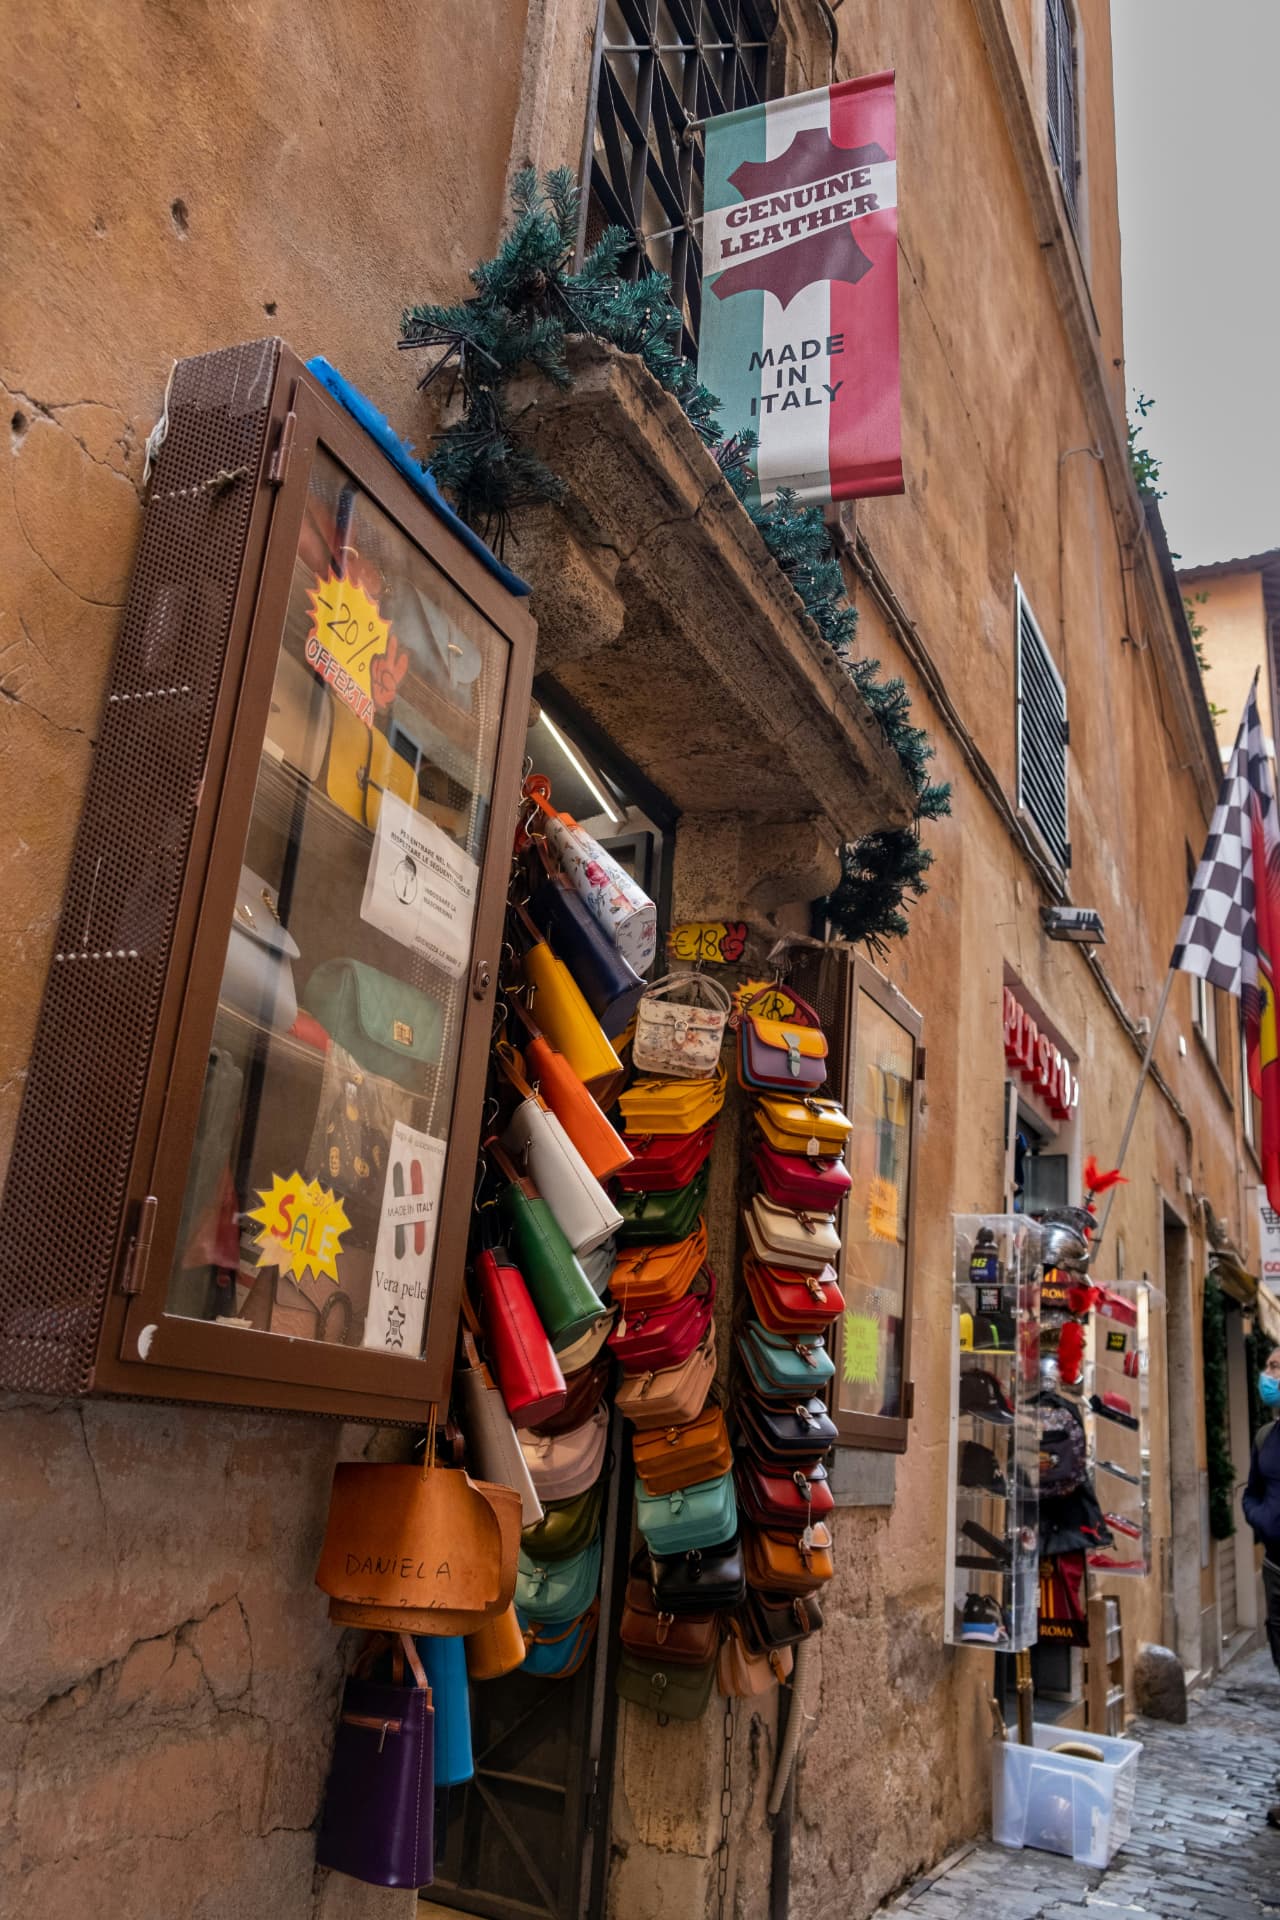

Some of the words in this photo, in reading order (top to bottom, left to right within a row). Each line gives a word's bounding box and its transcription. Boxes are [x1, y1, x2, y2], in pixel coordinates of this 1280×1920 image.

[725, 167, 872, 228] GENUINE
[720, 193, 880, 259] LEATHER
[748, 333, 845, 372] MADE
[776, 364, 808, 389] IN
[750, 381, 844, 416] ITALY
[318, 595, 380, 672] -20%
[307, 638, 376, 724] OFFERTA
[390, 831, 421, 859] RISPETTARE
[410, 836, 435, 858] ENTRARE
[435, 854, 446, 866] NEL
[387, 1205, 406, 1217] MADE
[416, 1200, 434, 1214] ITALY
[270, 1194, 337, 1264] SALE
[375, 1270, 399, 1293] Vera
[400, 1281, 427, 1301] pelle
[1040, 1625, 1073, 1638] ROMA
